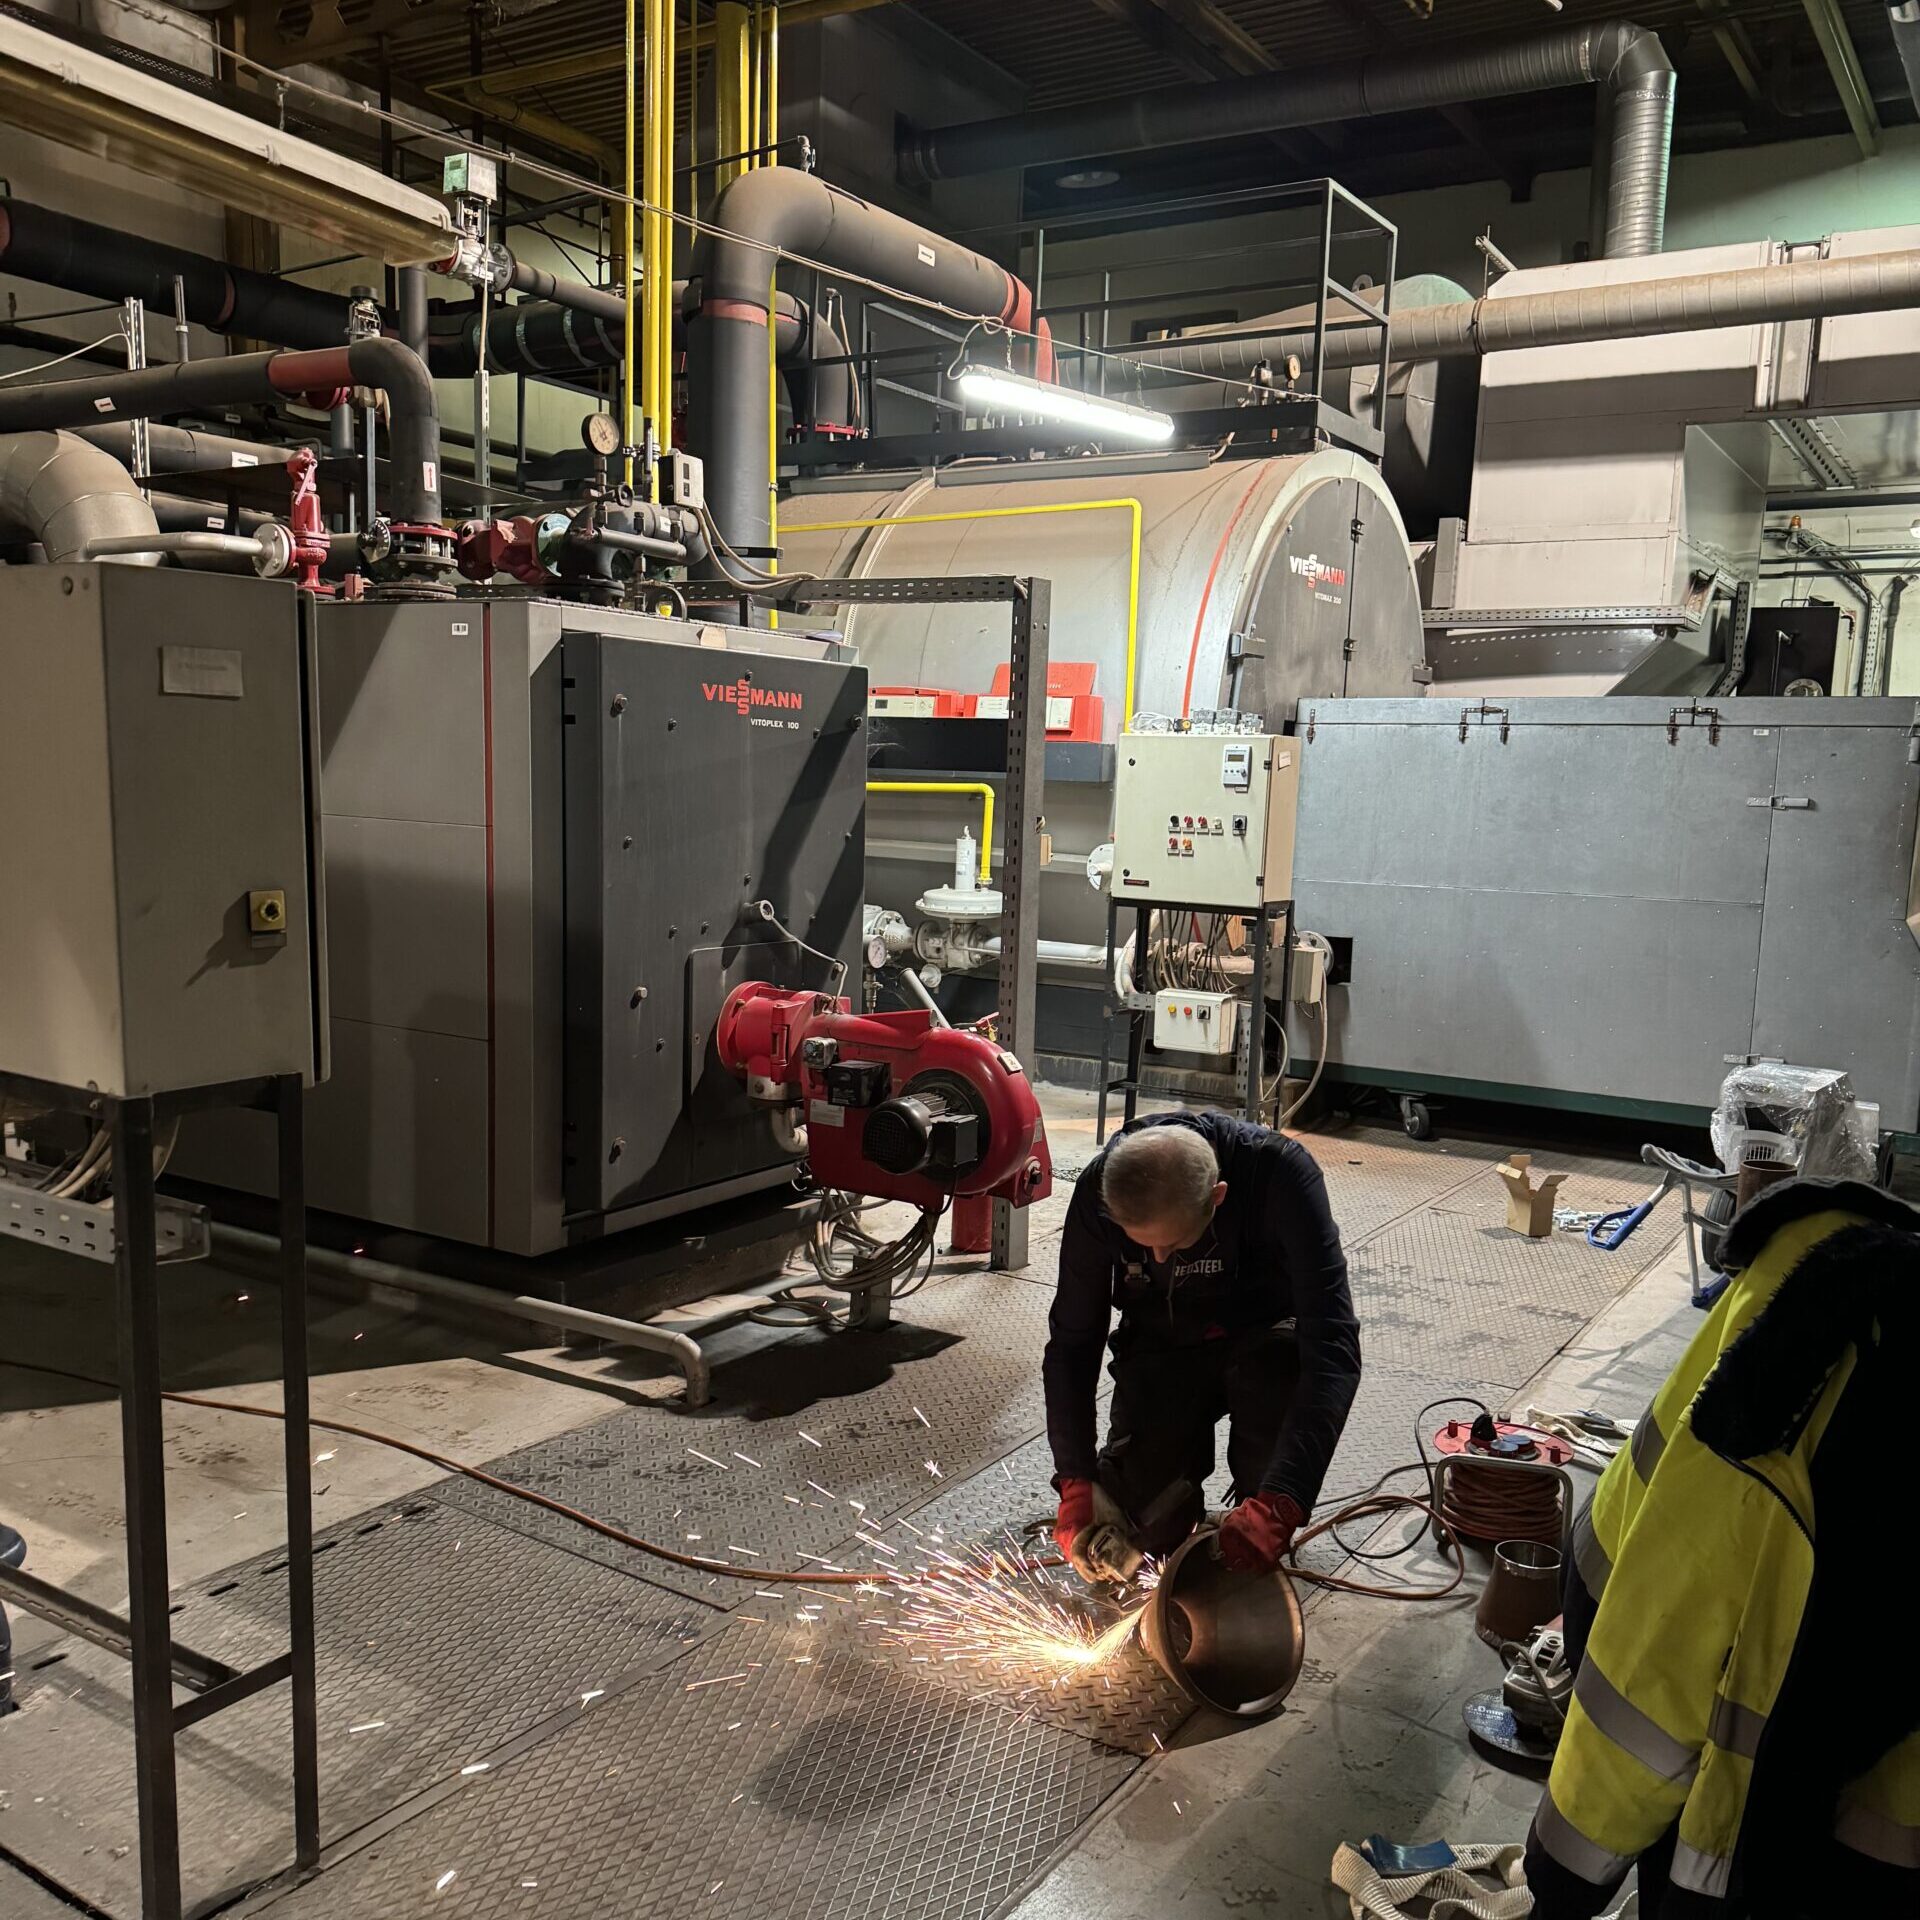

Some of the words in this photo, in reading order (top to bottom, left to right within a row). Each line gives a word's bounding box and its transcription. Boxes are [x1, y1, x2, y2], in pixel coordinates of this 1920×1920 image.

[1289, 553, 1345, 589] VIESSMANN
[702, 678, 803, 715] VIESSMANN
[750, 718, 783, 728] VITOPLEX
[787, 721, 800, 730] 100
